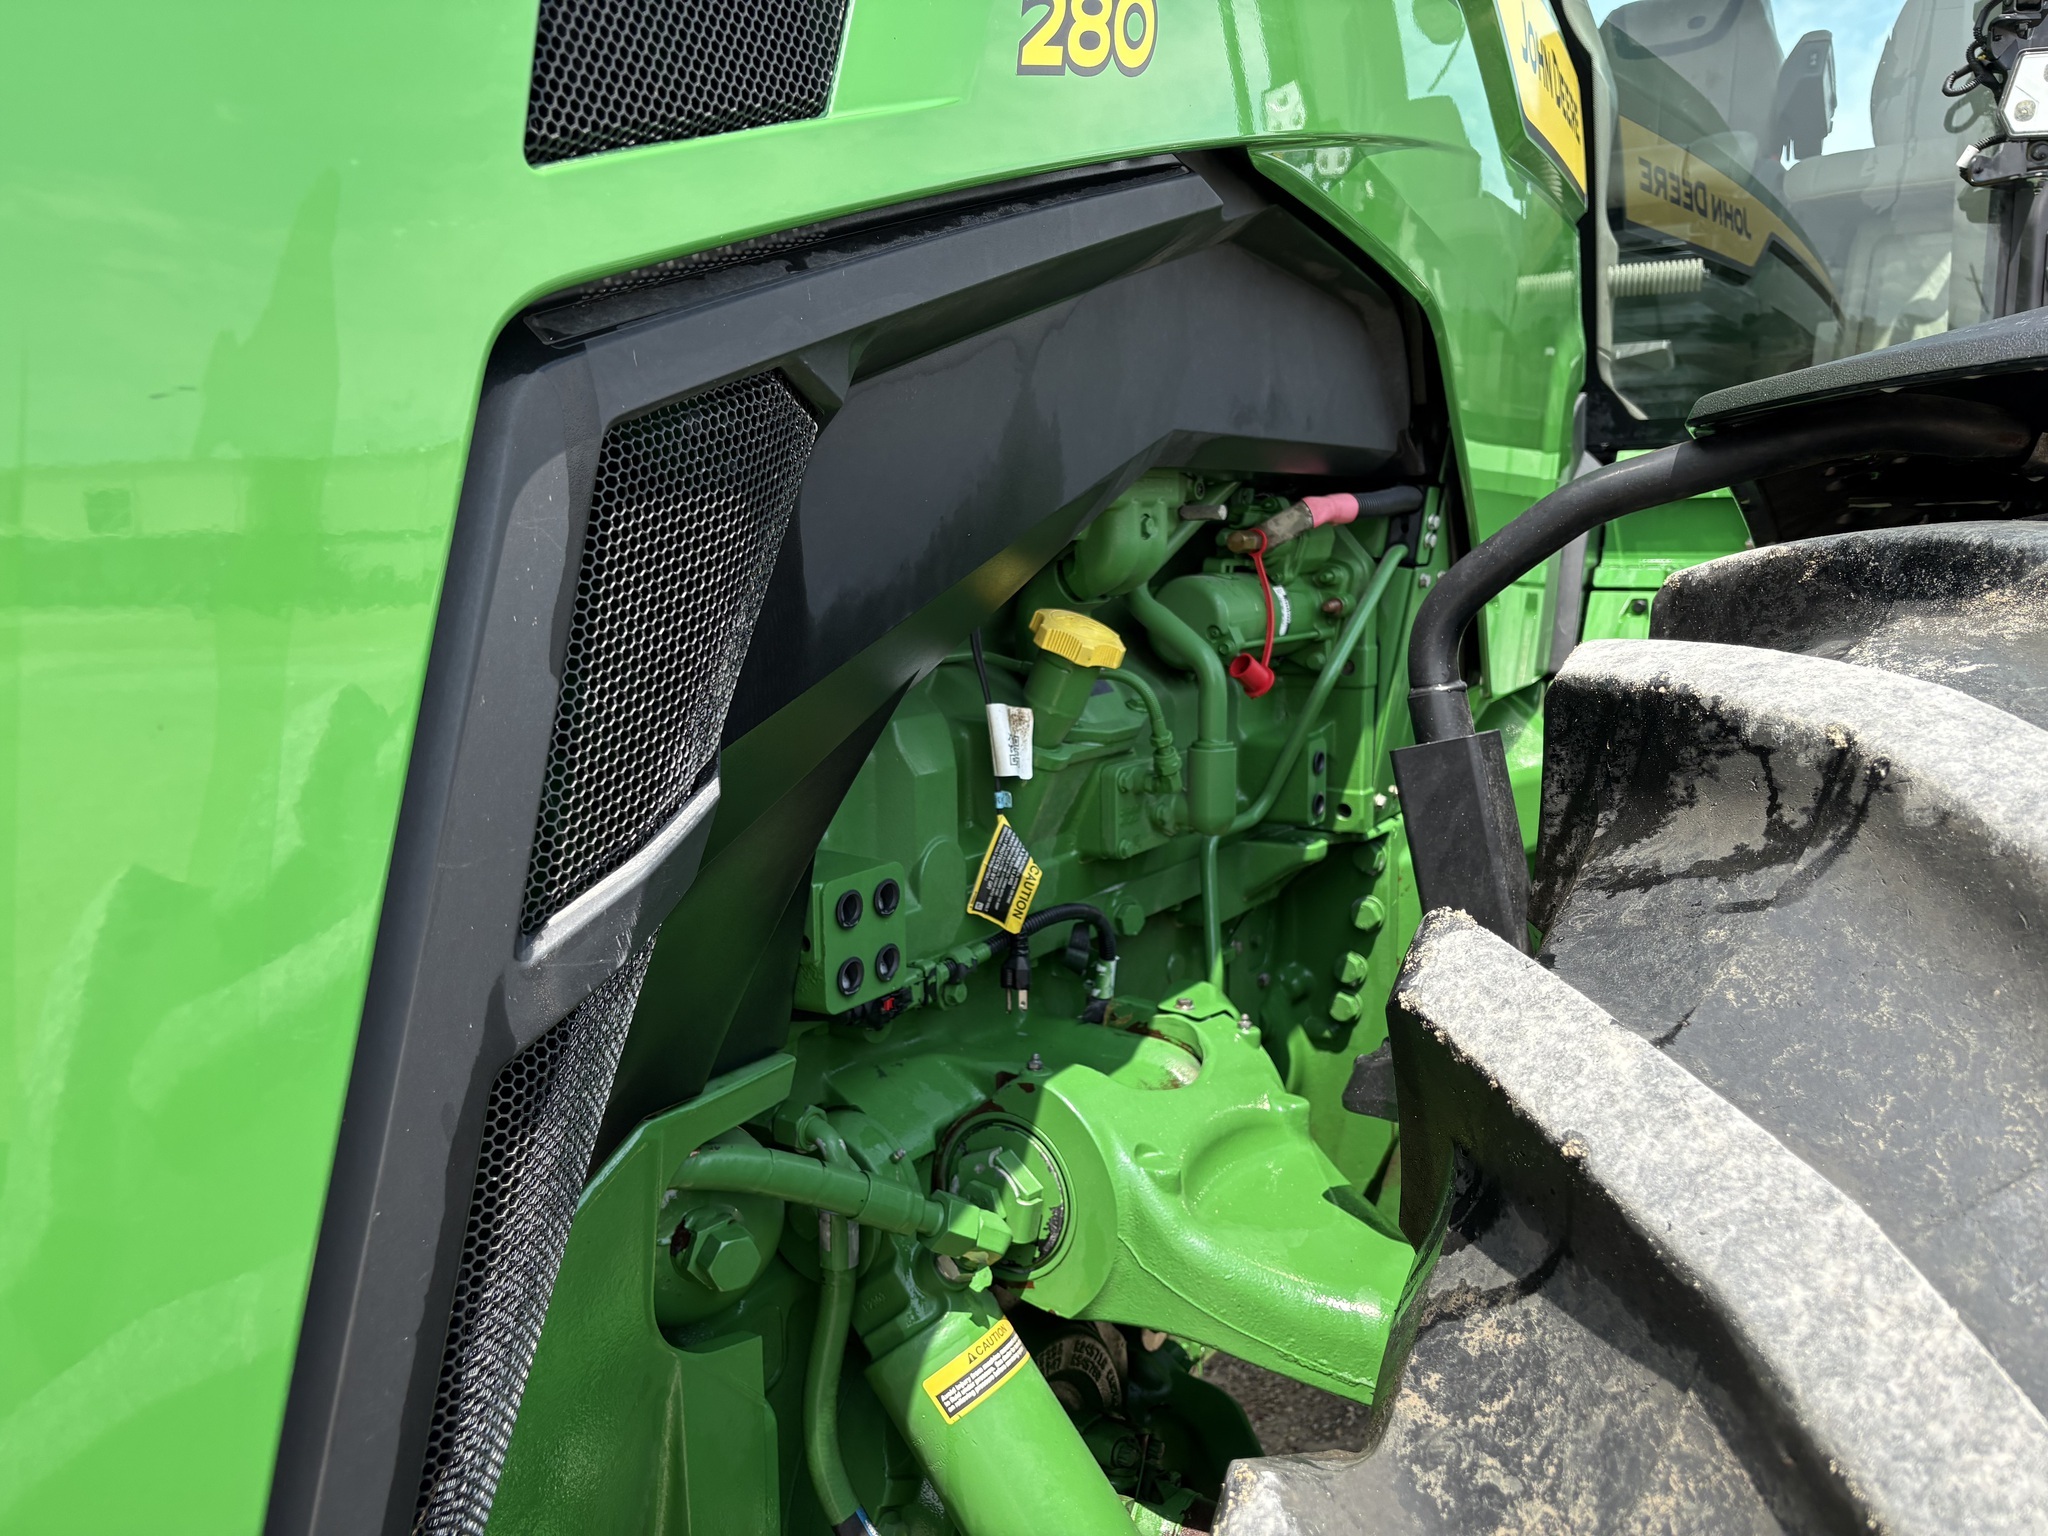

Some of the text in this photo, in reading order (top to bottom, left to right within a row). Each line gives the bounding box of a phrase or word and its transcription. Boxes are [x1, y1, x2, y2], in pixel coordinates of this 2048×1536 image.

[1017, 0, 1158, 77] 280
[1521, 0, 1554, 99] JOHN
[1012, 865, 1040, 920] CAUTION
[975, 1323, 1008, 1356] CAUTION
